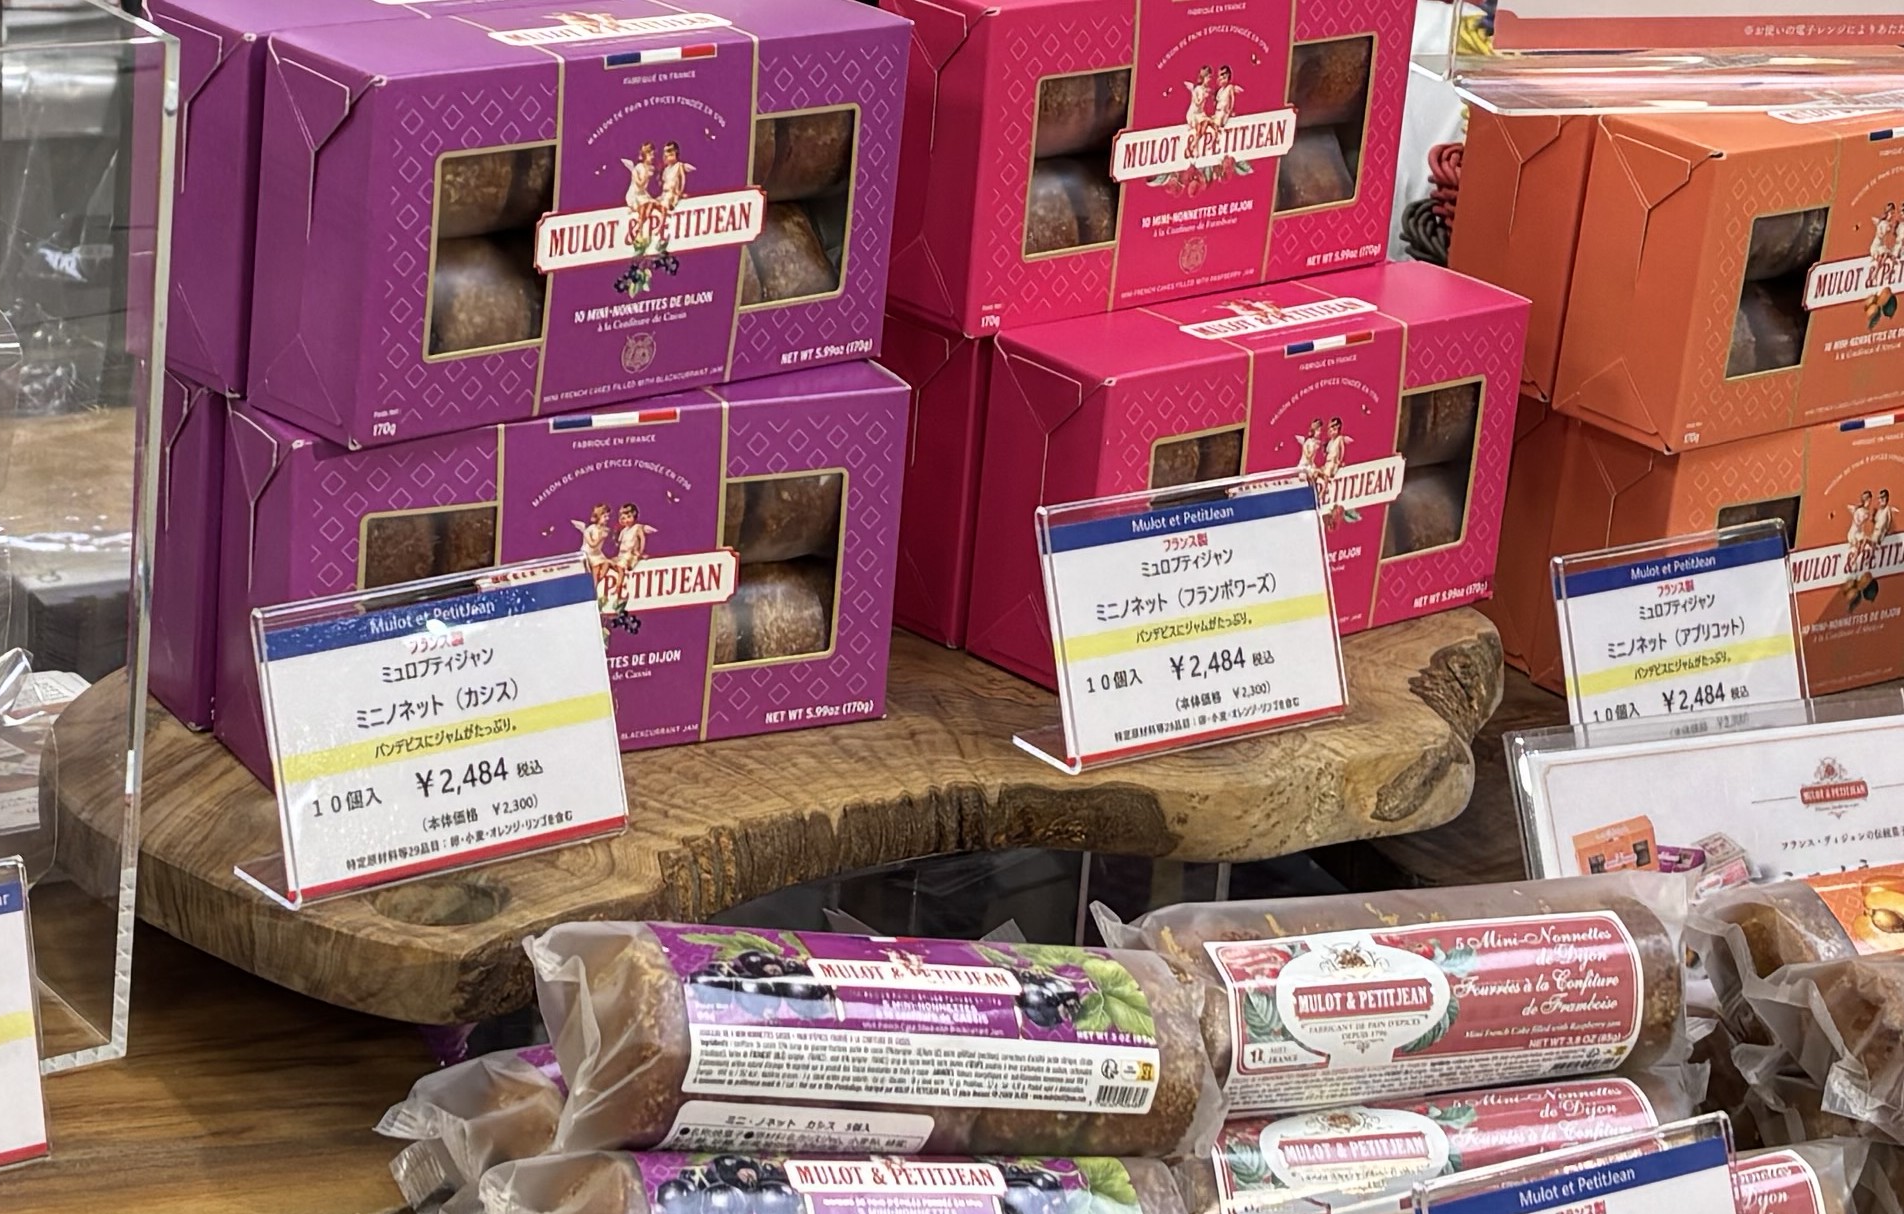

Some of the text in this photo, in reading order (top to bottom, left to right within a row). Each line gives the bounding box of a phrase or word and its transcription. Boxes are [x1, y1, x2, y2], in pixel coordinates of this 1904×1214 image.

[1123, 138, 1178, 171] MULOT
[1202, 119, 1286, 157] PETITJEAN
[548, 220, 619, 258] MULOT
[650, 201, 752, 241] PETITJEAN
[1814, 265, 1860, 298] MULOT
[1096, 572, 1277, 622] ミニノネット（フランボワーズ）
[1086, 668, 1142, 694] １０個入
[1170, 647, 1274, 681] ¥2,484 税込
[356, 678, 519, 729] ミニノネット（カシス）
[1662, 682, 1725, 714] ¥2,484
[374, 718, 517, 759] パンデピスにジャムがたっぷり。
[416, 757, 543, 798] ¥2,484 税込
[312, 788, 381, 818] １０個入
[1299, 985, 1428, 1013] MULOT & PETITJEAN
[797, 1166, 996, 1188] MULOT & PETITJEAN
[1519, 1167, 1635, 1208] Mulot et PetitJean
